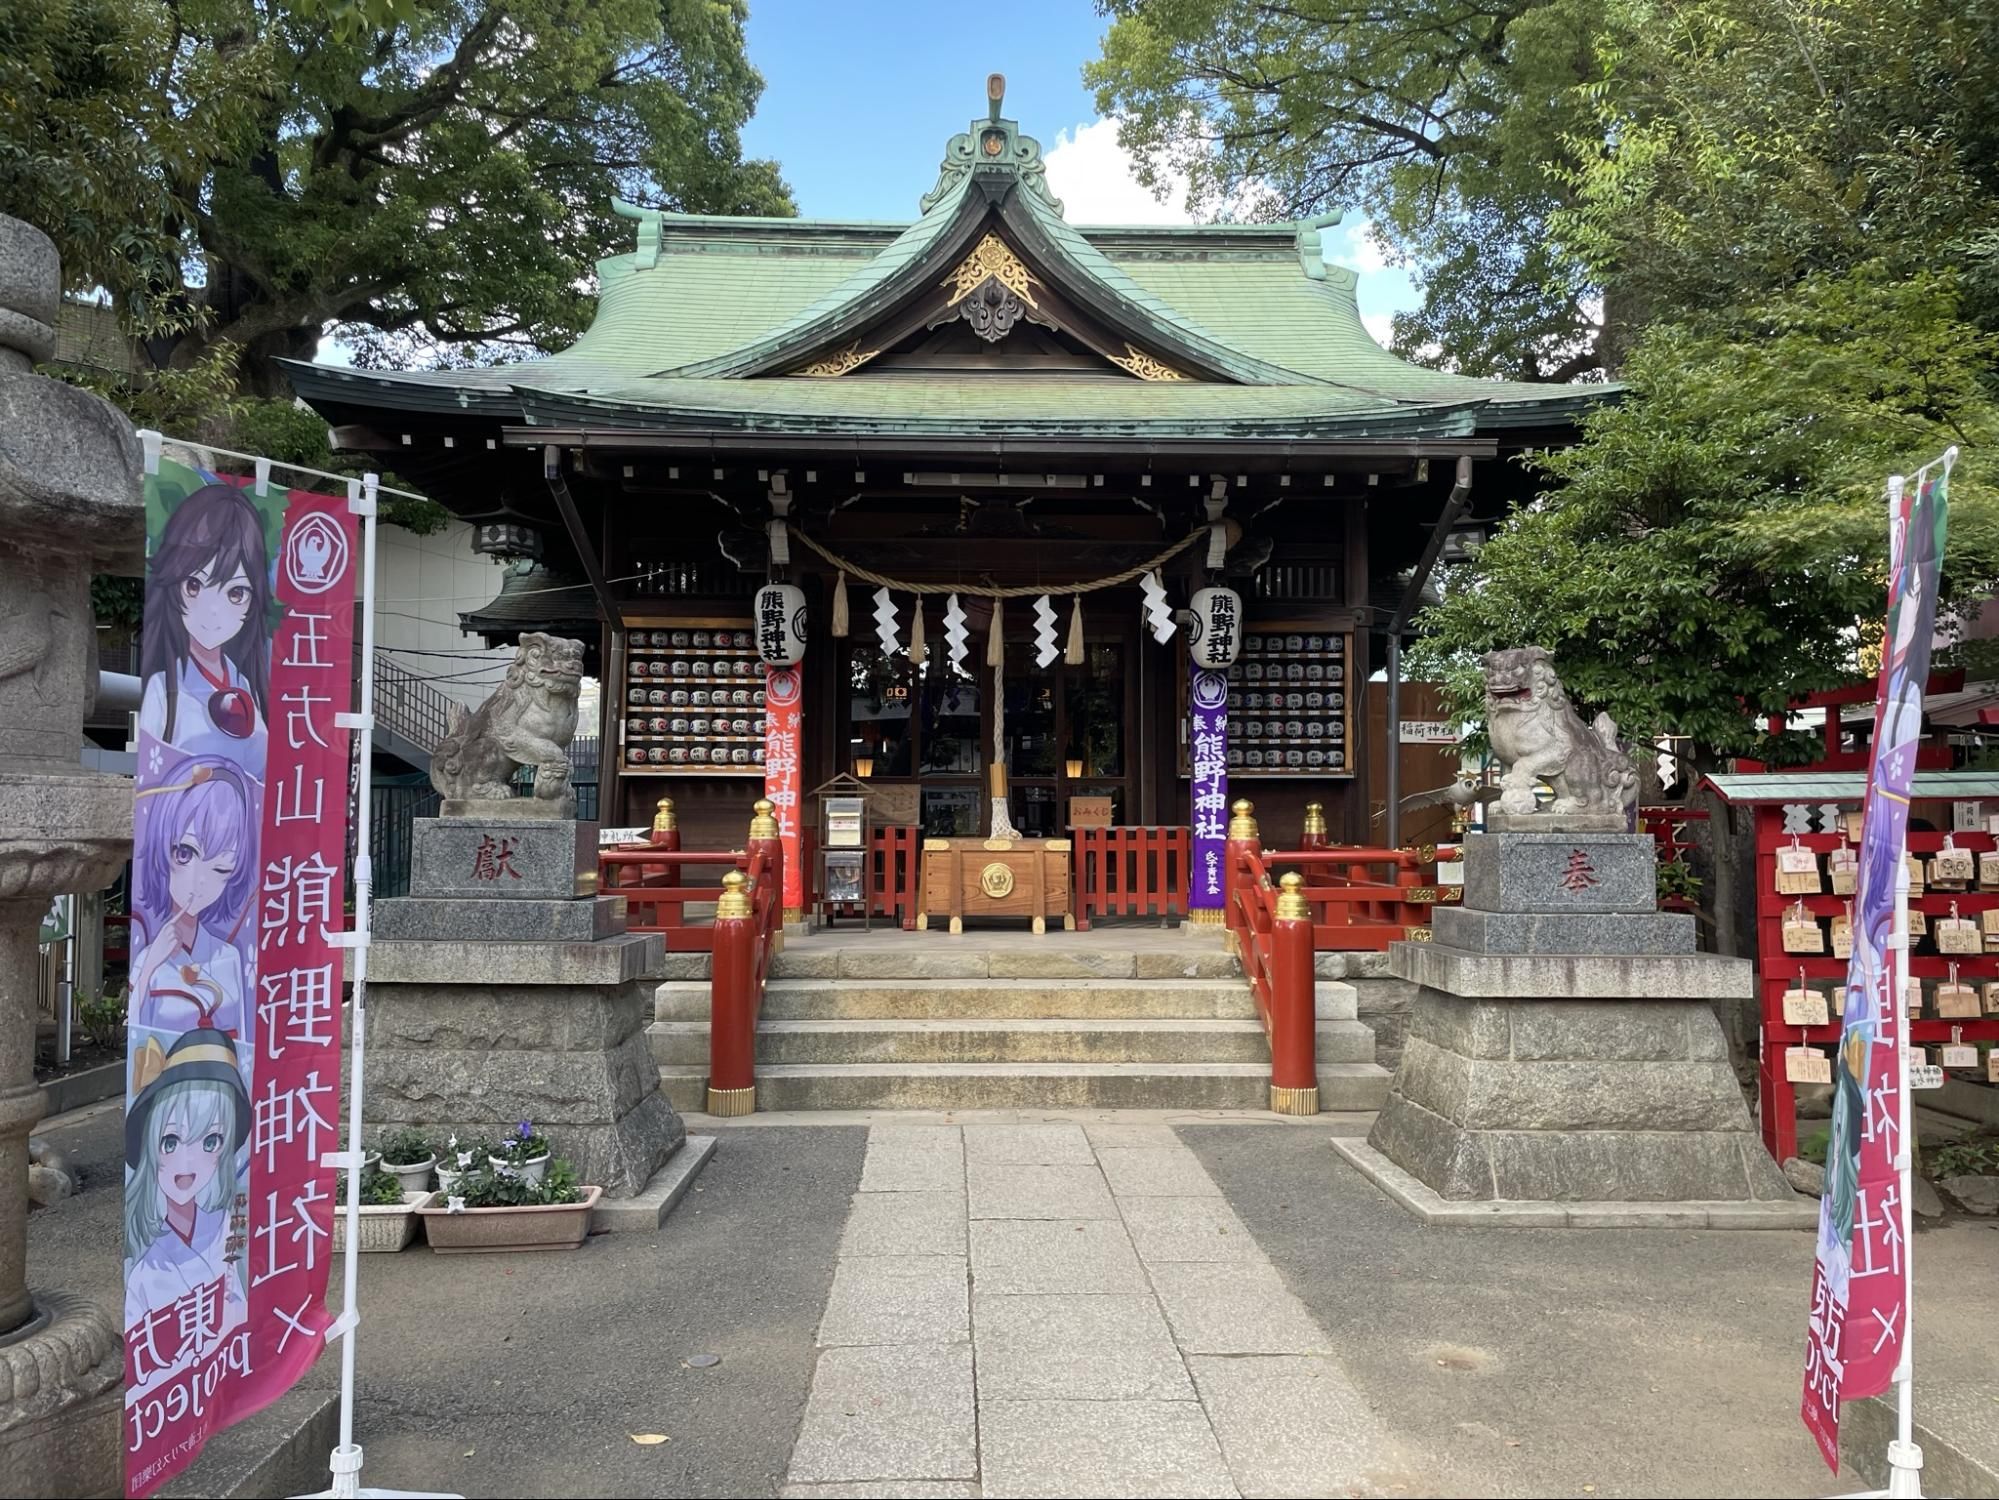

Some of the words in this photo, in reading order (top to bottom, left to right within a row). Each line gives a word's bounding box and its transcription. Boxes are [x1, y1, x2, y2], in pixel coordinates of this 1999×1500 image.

[761, 591, 789, 660] 熊野神社
[1206, 595, 1234, 663] 熊野神社
[1402, 723, 1453, 738] 稲荷神社
[1073, 807, 1108, 817] おみくじ
[1194, 732, 1226, 840] 熊野神社
[1557, 849, 1601, 895] 奉
